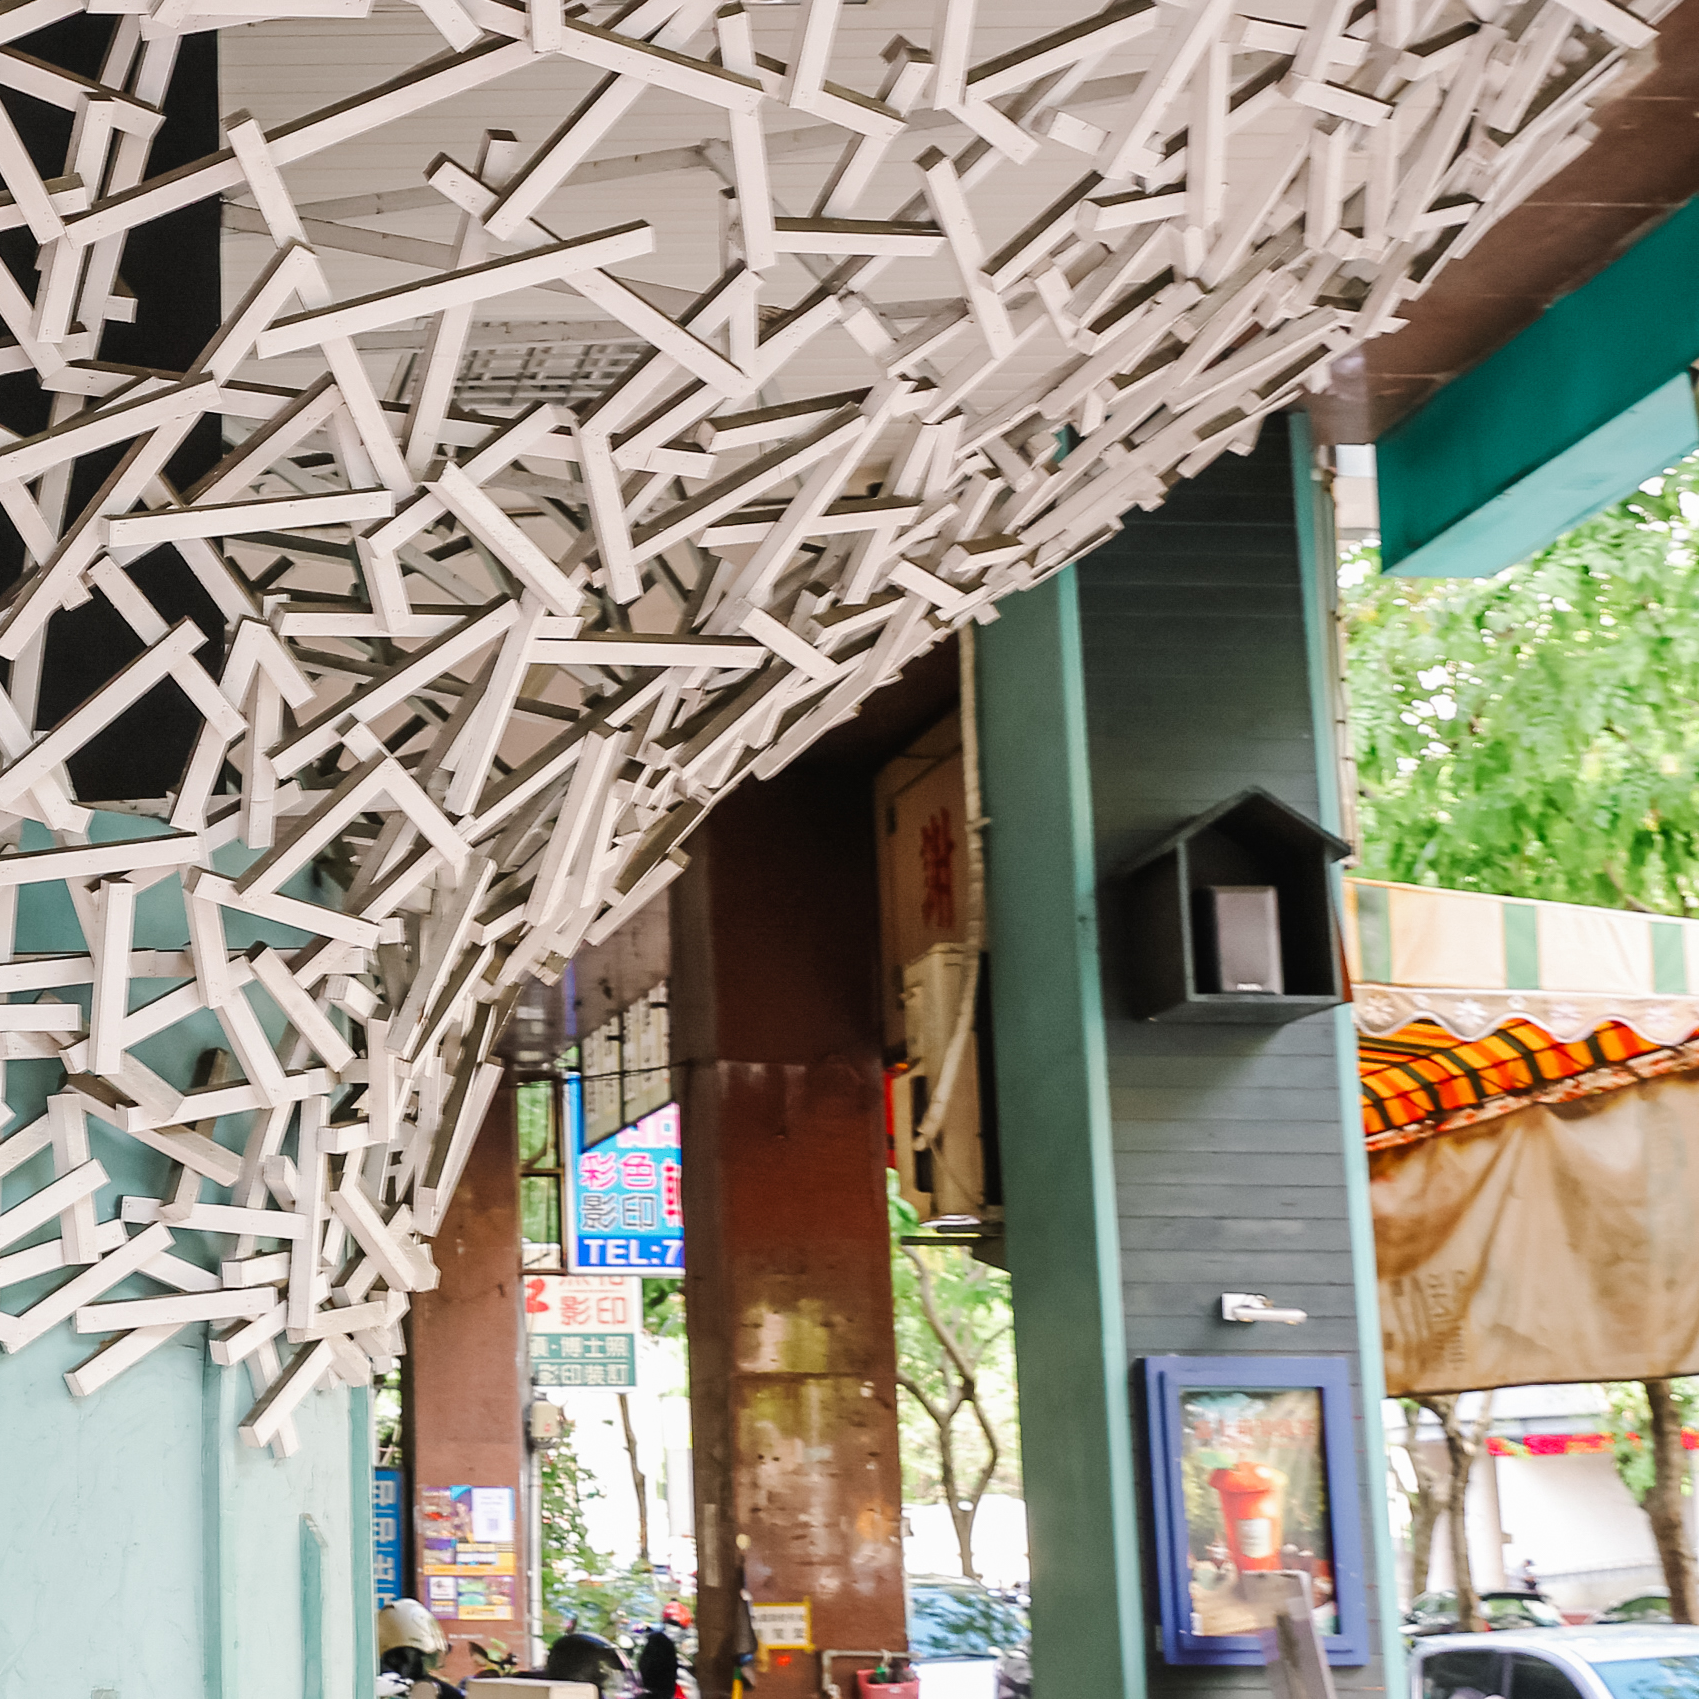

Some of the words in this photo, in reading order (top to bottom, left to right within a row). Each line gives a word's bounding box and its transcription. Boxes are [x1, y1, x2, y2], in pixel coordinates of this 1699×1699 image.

[580, 1153, 657, 1189] 彩色
[581, 1194, 656, 1231] 影印
[560, 1296, 626, 1325] 影印
